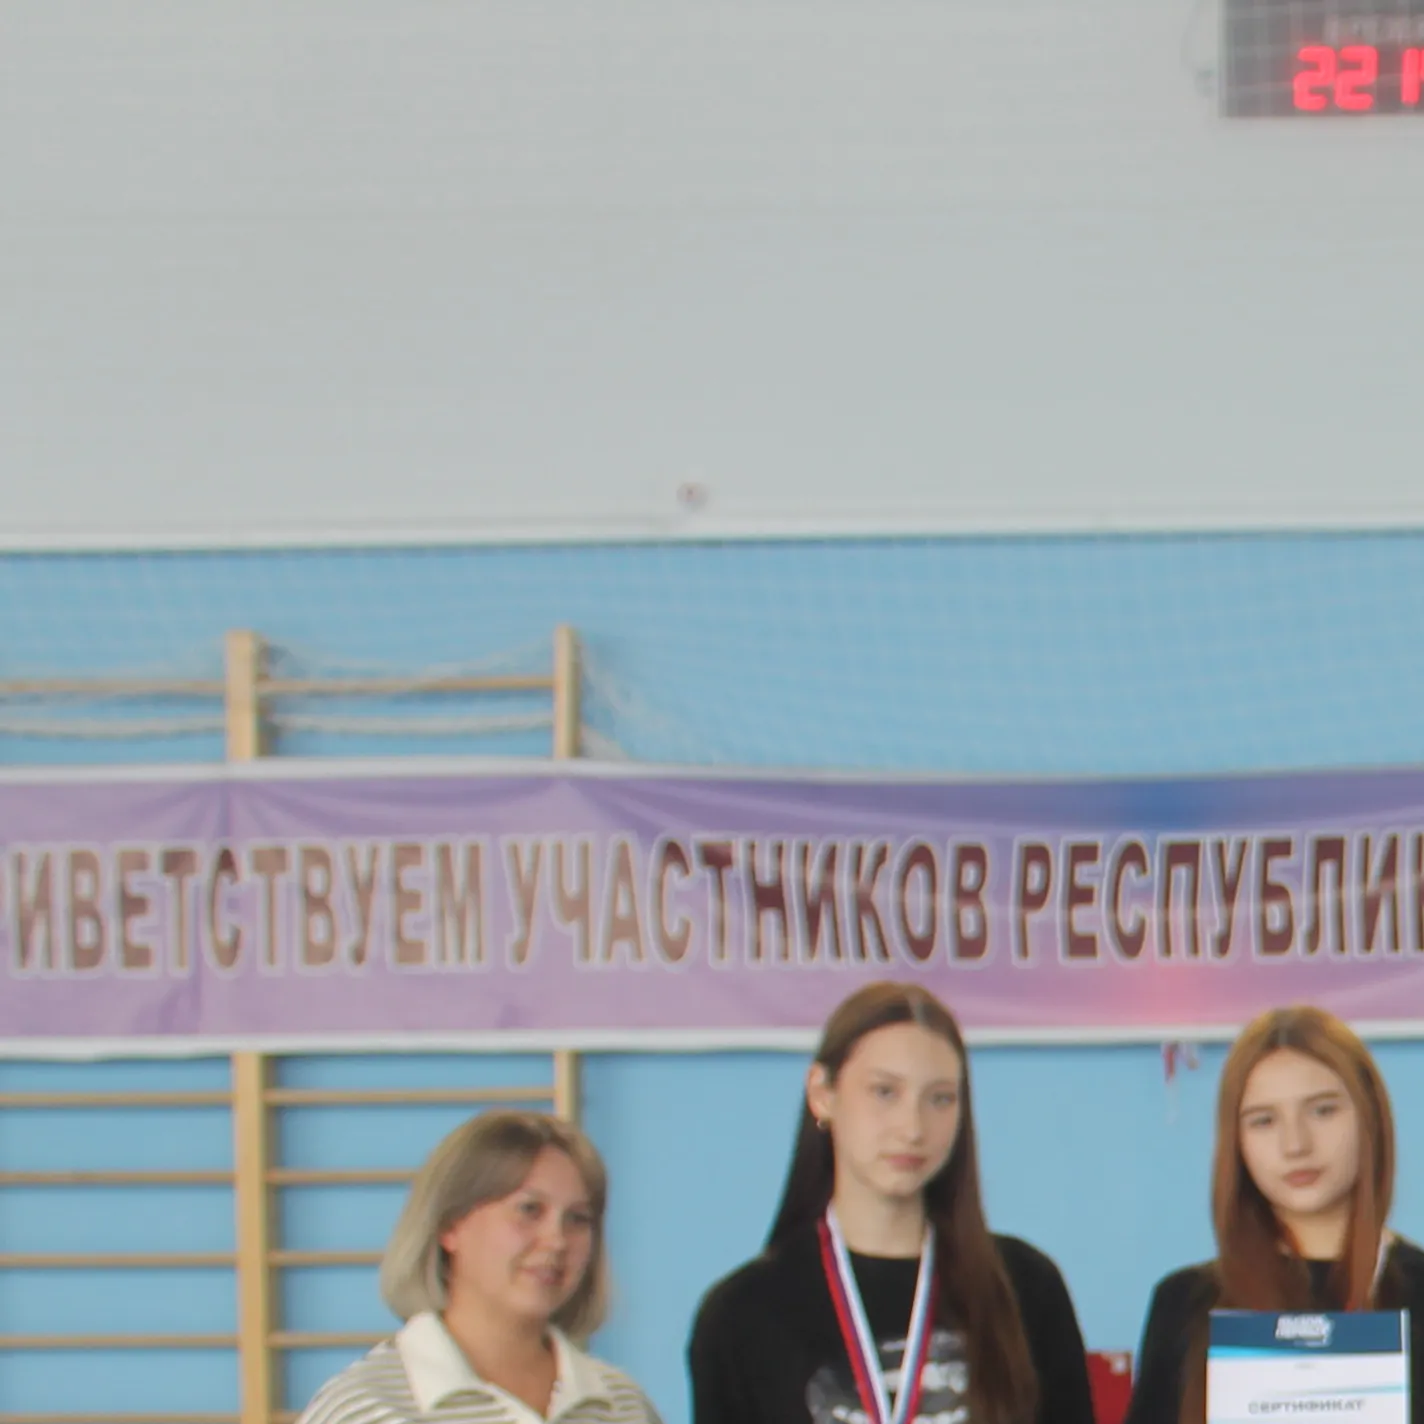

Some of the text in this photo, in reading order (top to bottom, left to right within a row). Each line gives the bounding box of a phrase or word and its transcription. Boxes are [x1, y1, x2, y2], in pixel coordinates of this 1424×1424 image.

[1293, 46, 1378, 111] 22
[9, 842, 487, 971] ИВЕТСТВУЕМ
[505, 838, 990, 966] УЧАСТНИКОВ
